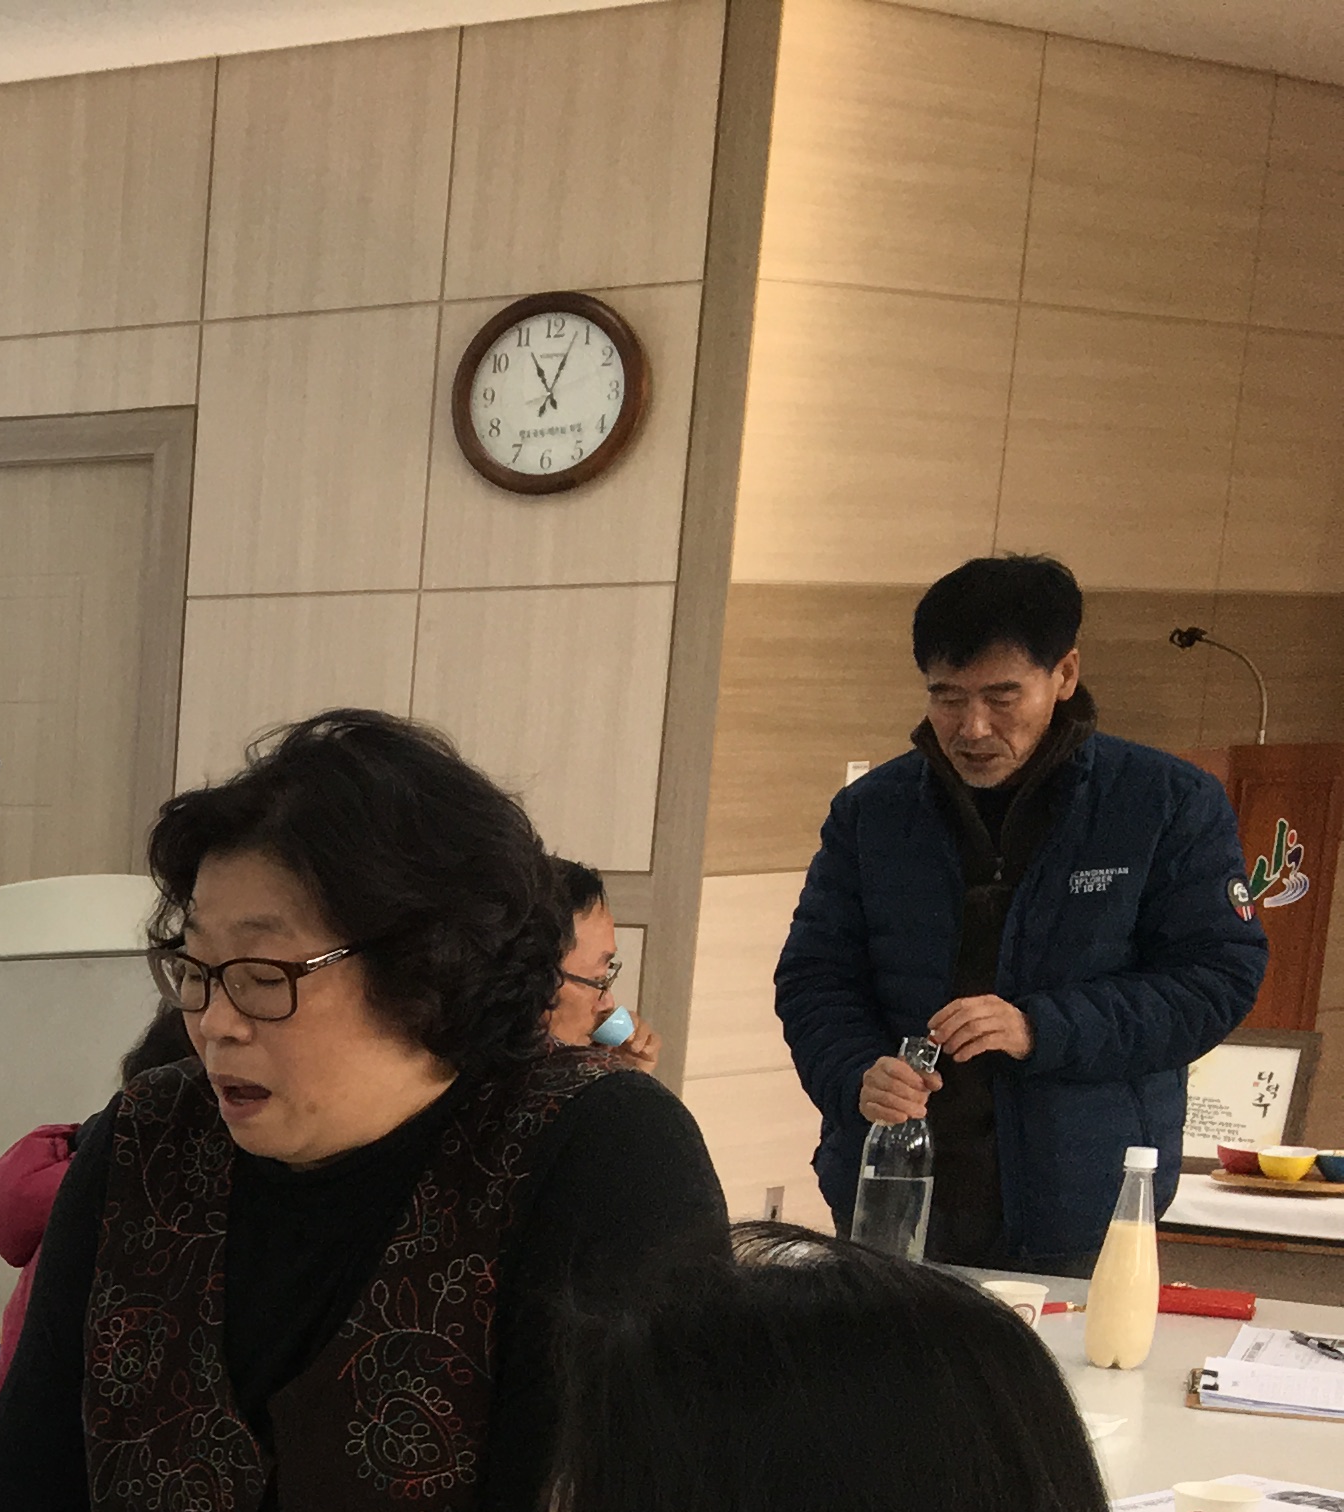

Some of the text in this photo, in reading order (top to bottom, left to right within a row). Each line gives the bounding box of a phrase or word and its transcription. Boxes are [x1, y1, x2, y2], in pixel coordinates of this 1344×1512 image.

[516, 327, 530, 347] 11
[546, 318, 566, 339] 12
[584, 325, 590, 345] 1
[492, 353, 510, 374] 10
[601, 345, 614, 366] 2
[483, 387, 495, 408] 9
[607, 380, 620, 401] 3
[488, 417, 501, 438] 8
[595, 414, 606, 434] 4
[511, 444, 523, 464] 7
[539, 449, 552, 469] 6
[571, 440, 584, 460] 5
